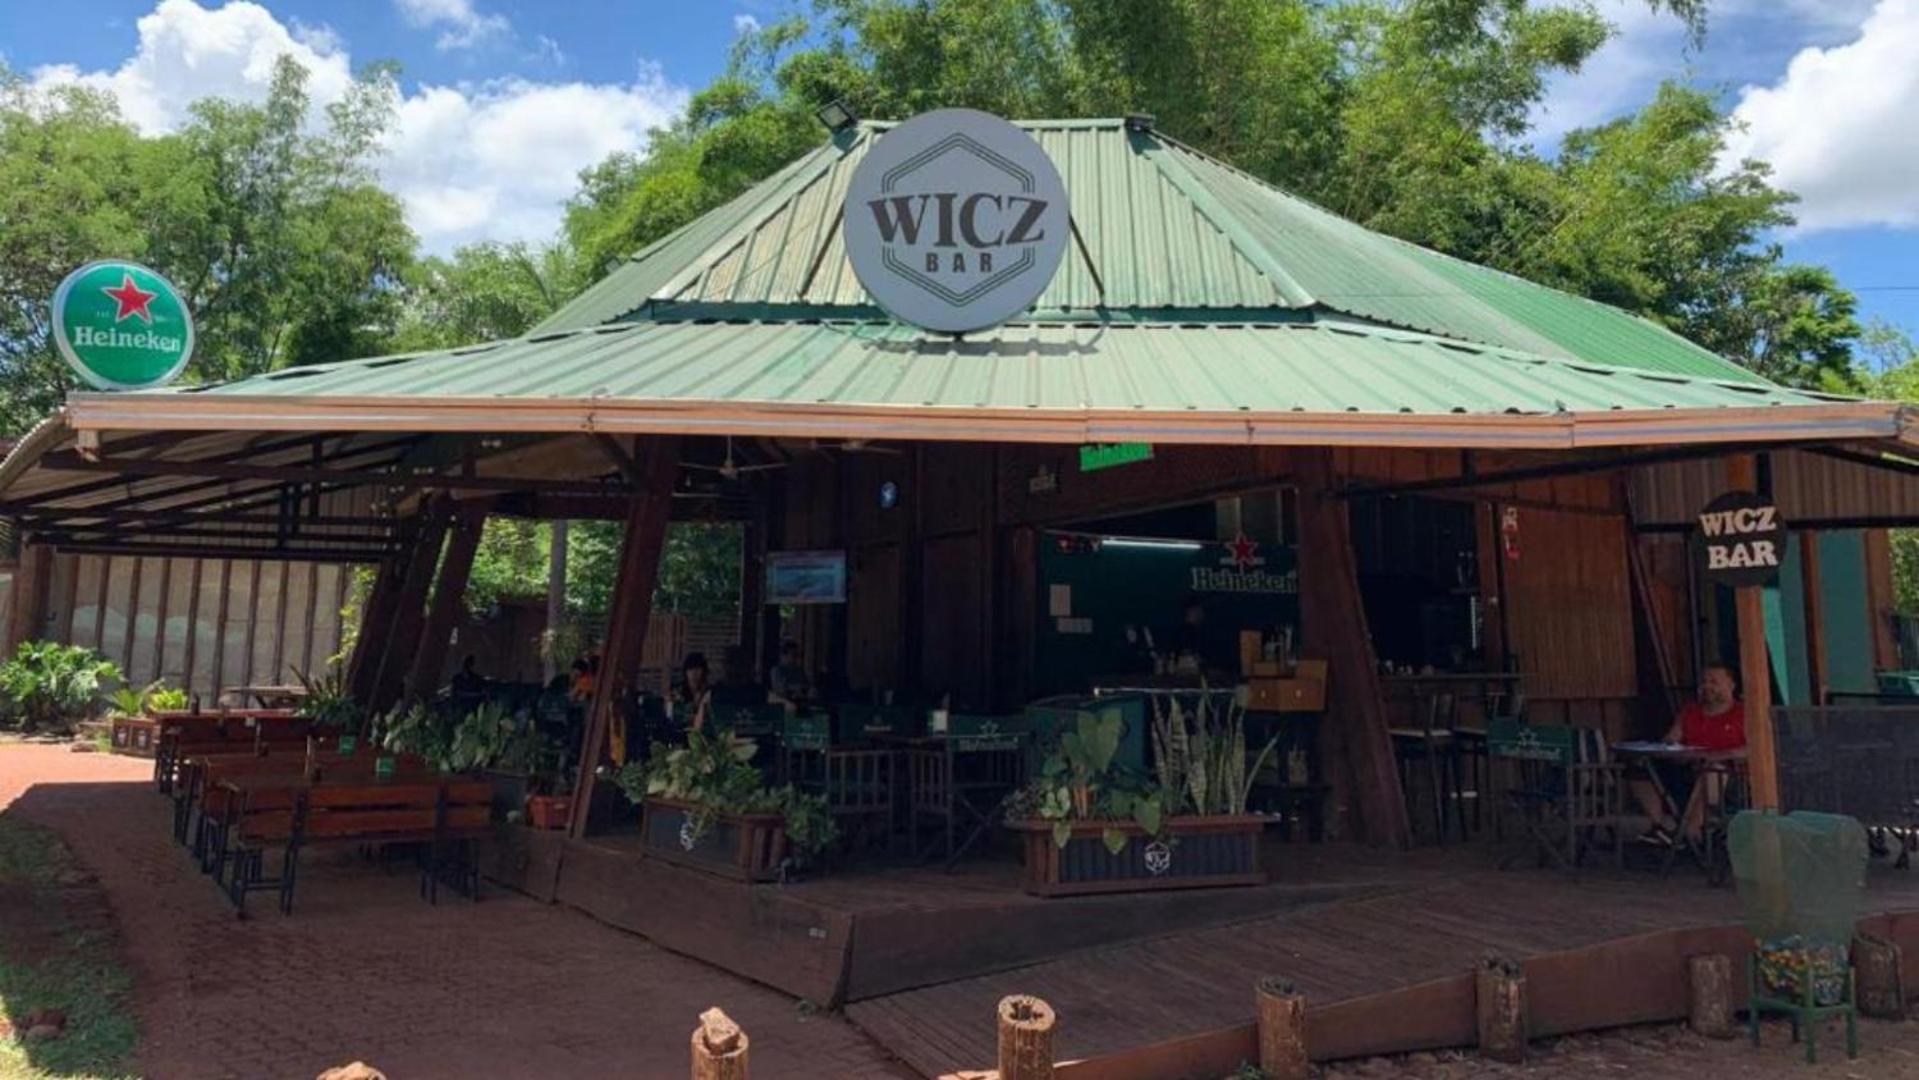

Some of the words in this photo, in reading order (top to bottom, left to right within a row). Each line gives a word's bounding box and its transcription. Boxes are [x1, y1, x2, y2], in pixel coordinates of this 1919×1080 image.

[867, 193, 1048, 249] WICZ
[926, 252, 992, 273] BAR
[73, 325, 181, 353] Heineken
[1699, 506, 1777, 538] WICZ
[1707, 541, 1779, 569] BAR
